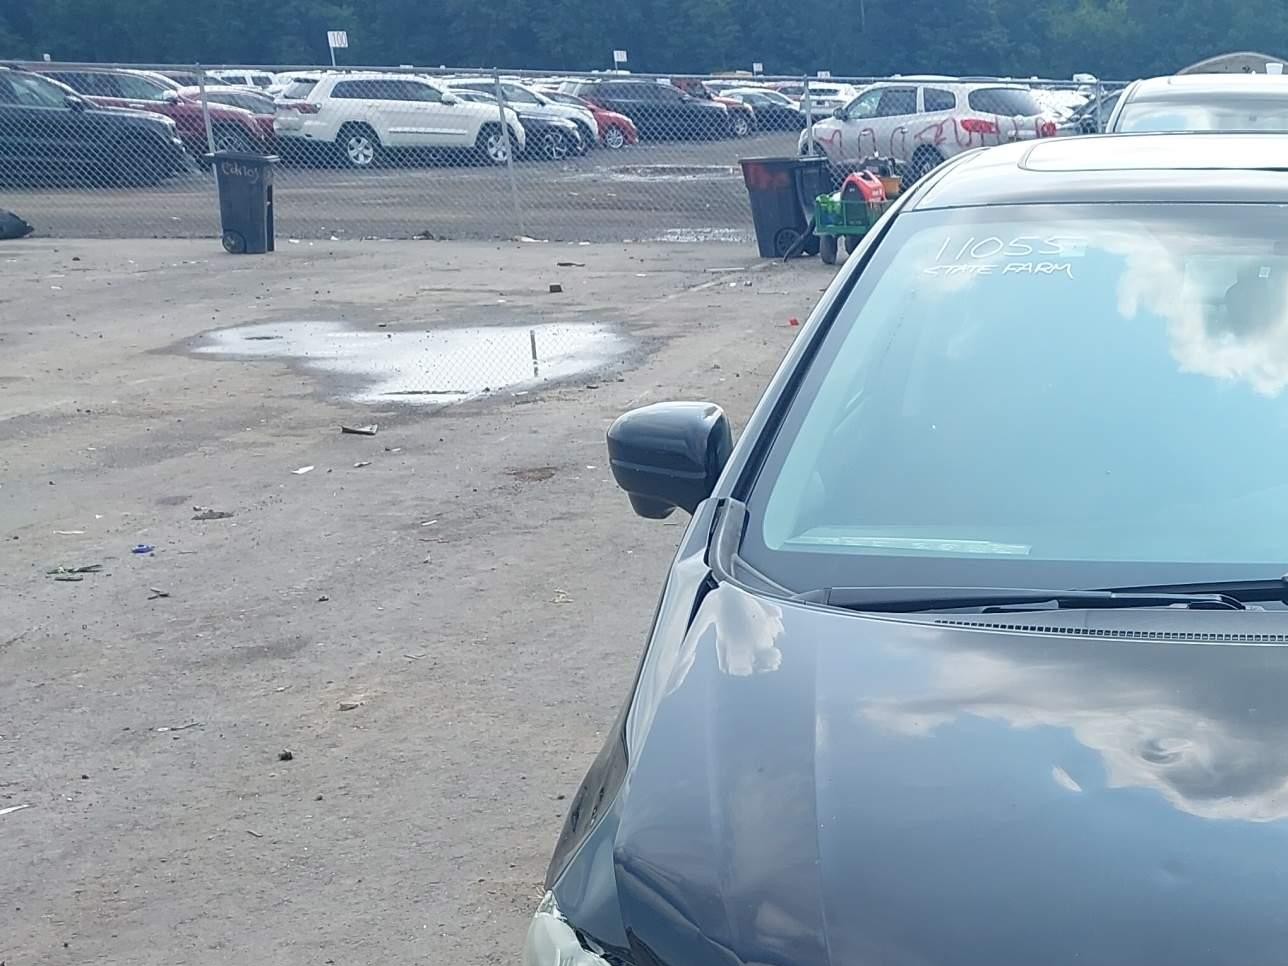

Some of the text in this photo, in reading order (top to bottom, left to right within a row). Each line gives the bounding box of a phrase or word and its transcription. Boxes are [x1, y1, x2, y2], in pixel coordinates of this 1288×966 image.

[936, 236, 1088, 260] 11055
[923, 262, 1074, 280] STATE FARM
